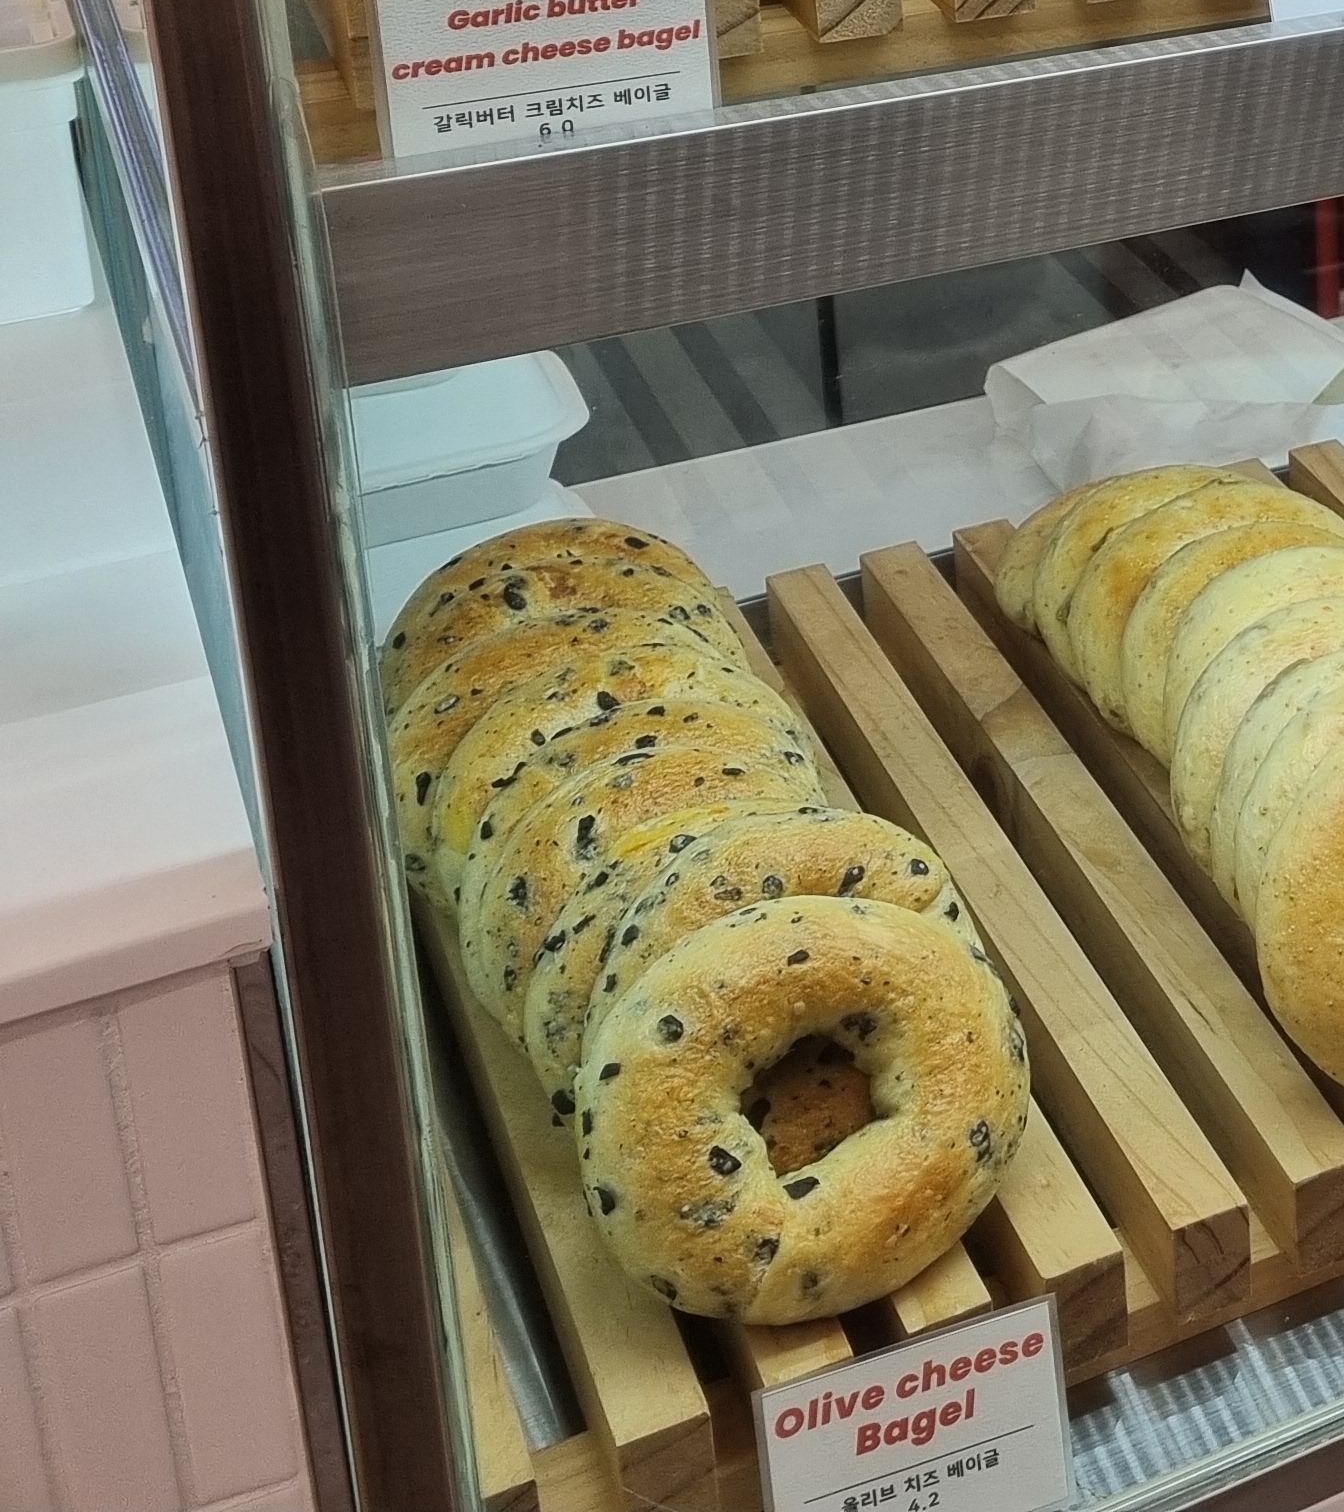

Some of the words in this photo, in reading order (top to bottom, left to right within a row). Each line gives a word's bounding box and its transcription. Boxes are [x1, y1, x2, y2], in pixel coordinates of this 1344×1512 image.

[447, 0, 540, 30] Garlic
[392, 52, 495, 80] cream
[502, 35, 611, 64] cheese
[617, 19, 700, 50] bagel
[434, 105, 515, 133] 갈릭버터
[525, 93, 604, 119] 크림치즈
[613, 83, 671, 105] 베이글
[775, 1385, 885, 1439] Olive
[896, 1332, 1043, 1399] cheese
[857, 1389, 976, 1455] Bagel
[841, 1485, 896, 1512] 올리브
[904, 1471, 940, 1493] 치즈
[947, 1448, 1000, 1477] 베이글
[908, 1492, 940, 1512] 4.2
